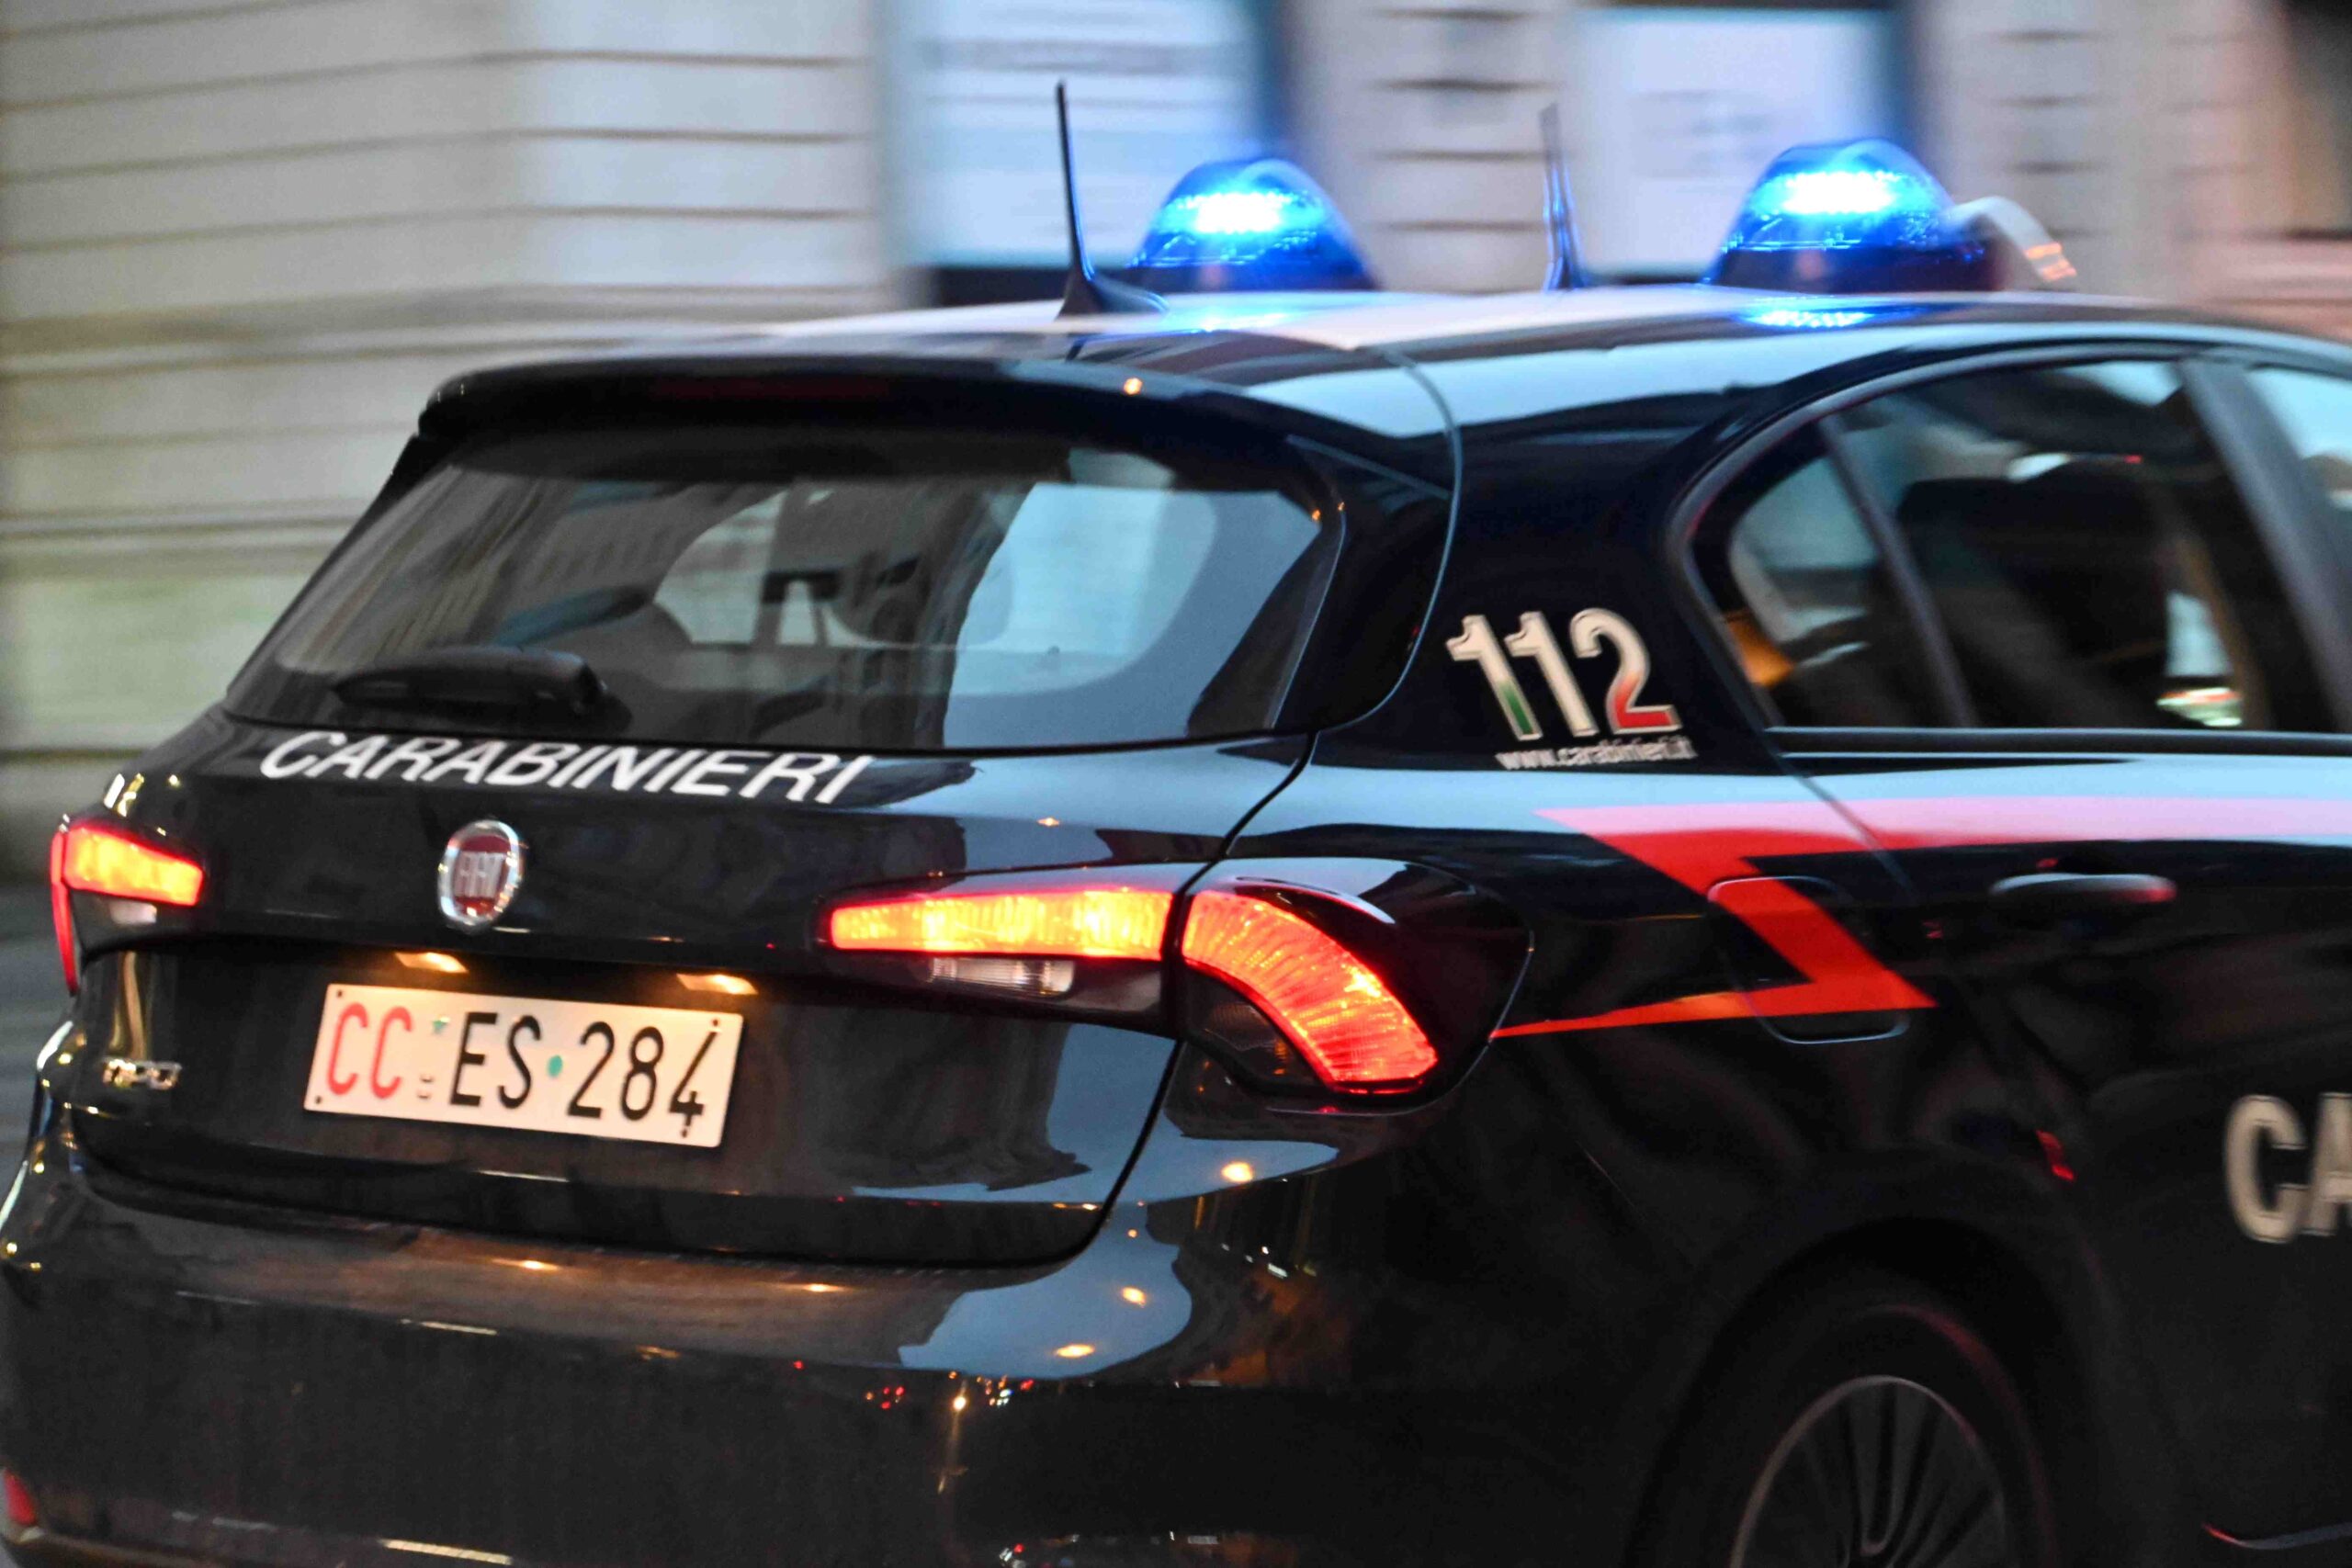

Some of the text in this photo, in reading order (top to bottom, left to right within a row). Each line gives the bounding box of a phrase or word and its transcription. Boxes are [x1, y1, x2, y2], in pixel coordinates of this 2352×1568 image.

[1445, 607, 1682, 740] 112
[261, 731, 873, 804] CARABINIERI
[326, 1002, 719, 1128] CC ES 284
